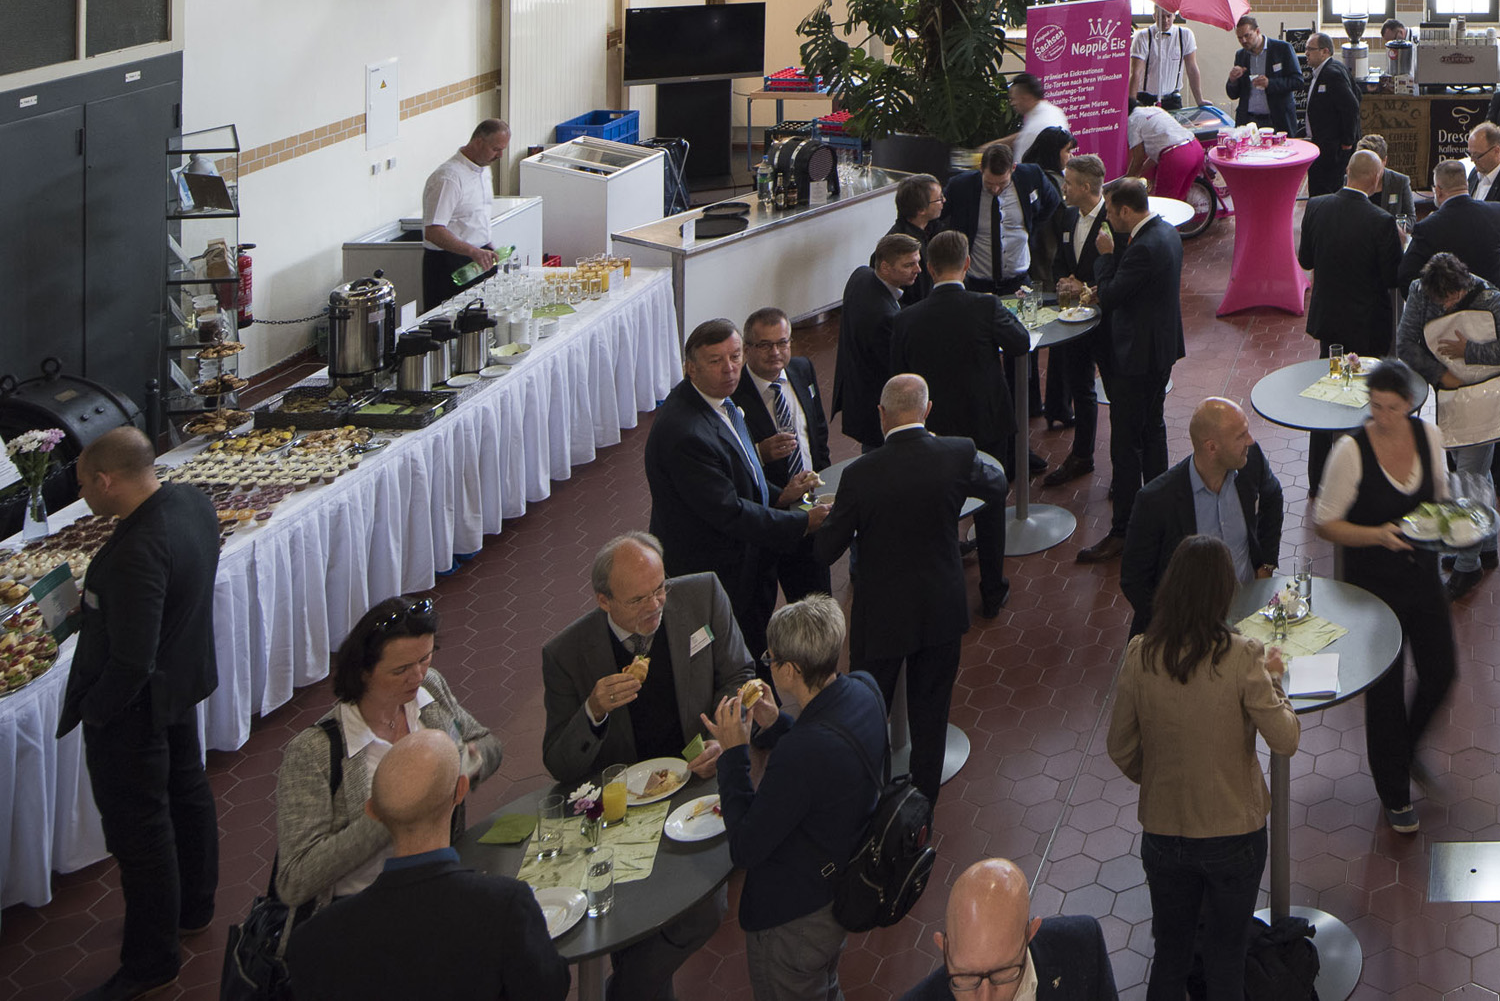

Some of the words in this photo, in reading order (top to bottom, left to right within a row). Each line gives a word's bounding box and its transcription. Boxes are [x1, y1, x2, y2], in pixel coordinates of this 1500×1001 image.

[1034, 30, 1065, 57] Sachsen
[1071, 40, 1108, 57] Nepple
[1110, 37, 1126, 50] Eis
[1043, 72, 1069, 83] prämierte
[1069, 67, 1105, 78] Eiskreationen
[1043, 80, 1070, 90] Eis-Torten
[1070, 77, 1083, 85] nach
[1083, 76, 1097, 84] Ihren
[1097, 73, 1123, 82] Wünschen
[1091, 100, 1109, 108] Mieten
[1079, 110, 1101, 119] Messen,
[1082, 125, 1113, 135] Gastronomie
[1438, 144, 1459, 153] Kaffee
